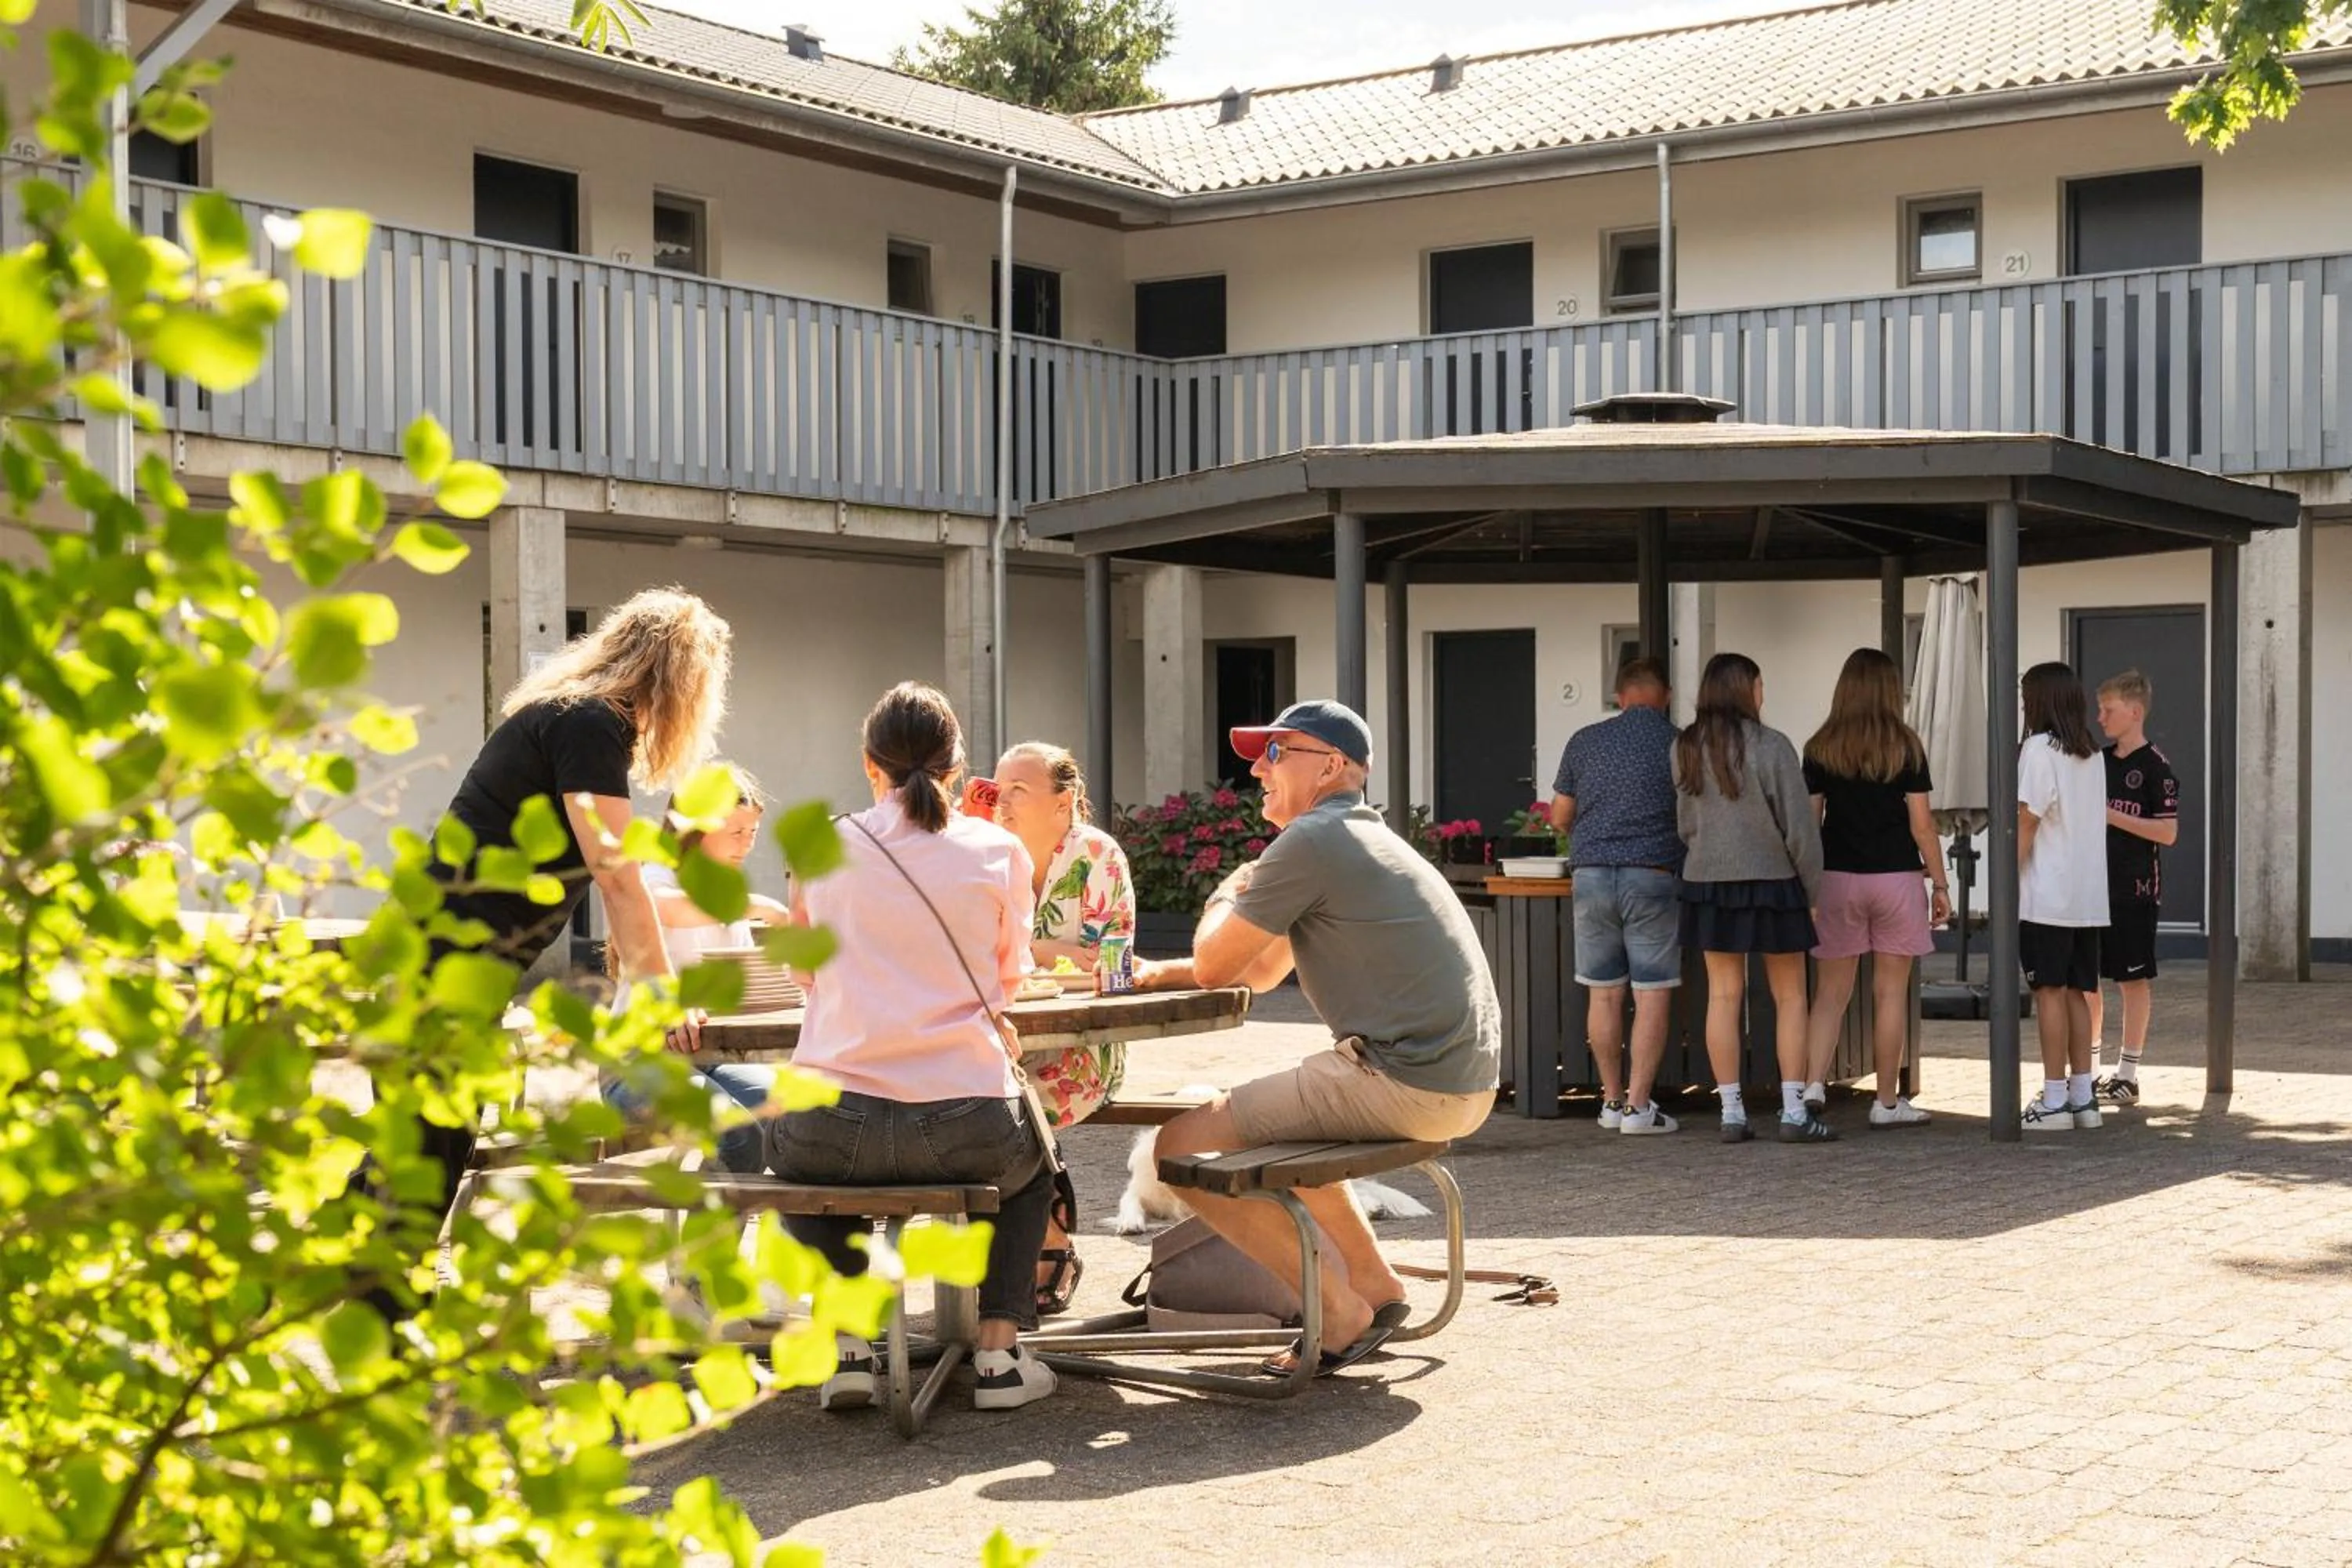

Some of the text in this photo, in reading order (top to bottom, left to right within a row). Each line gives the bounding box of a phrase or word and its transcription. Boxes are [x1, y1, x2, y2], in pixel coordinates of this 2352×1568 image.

[2006, 255, 2024, 272] 21
[1557, 299, 1577, 315] 20
[1563, 683, 1574, 699] 2
